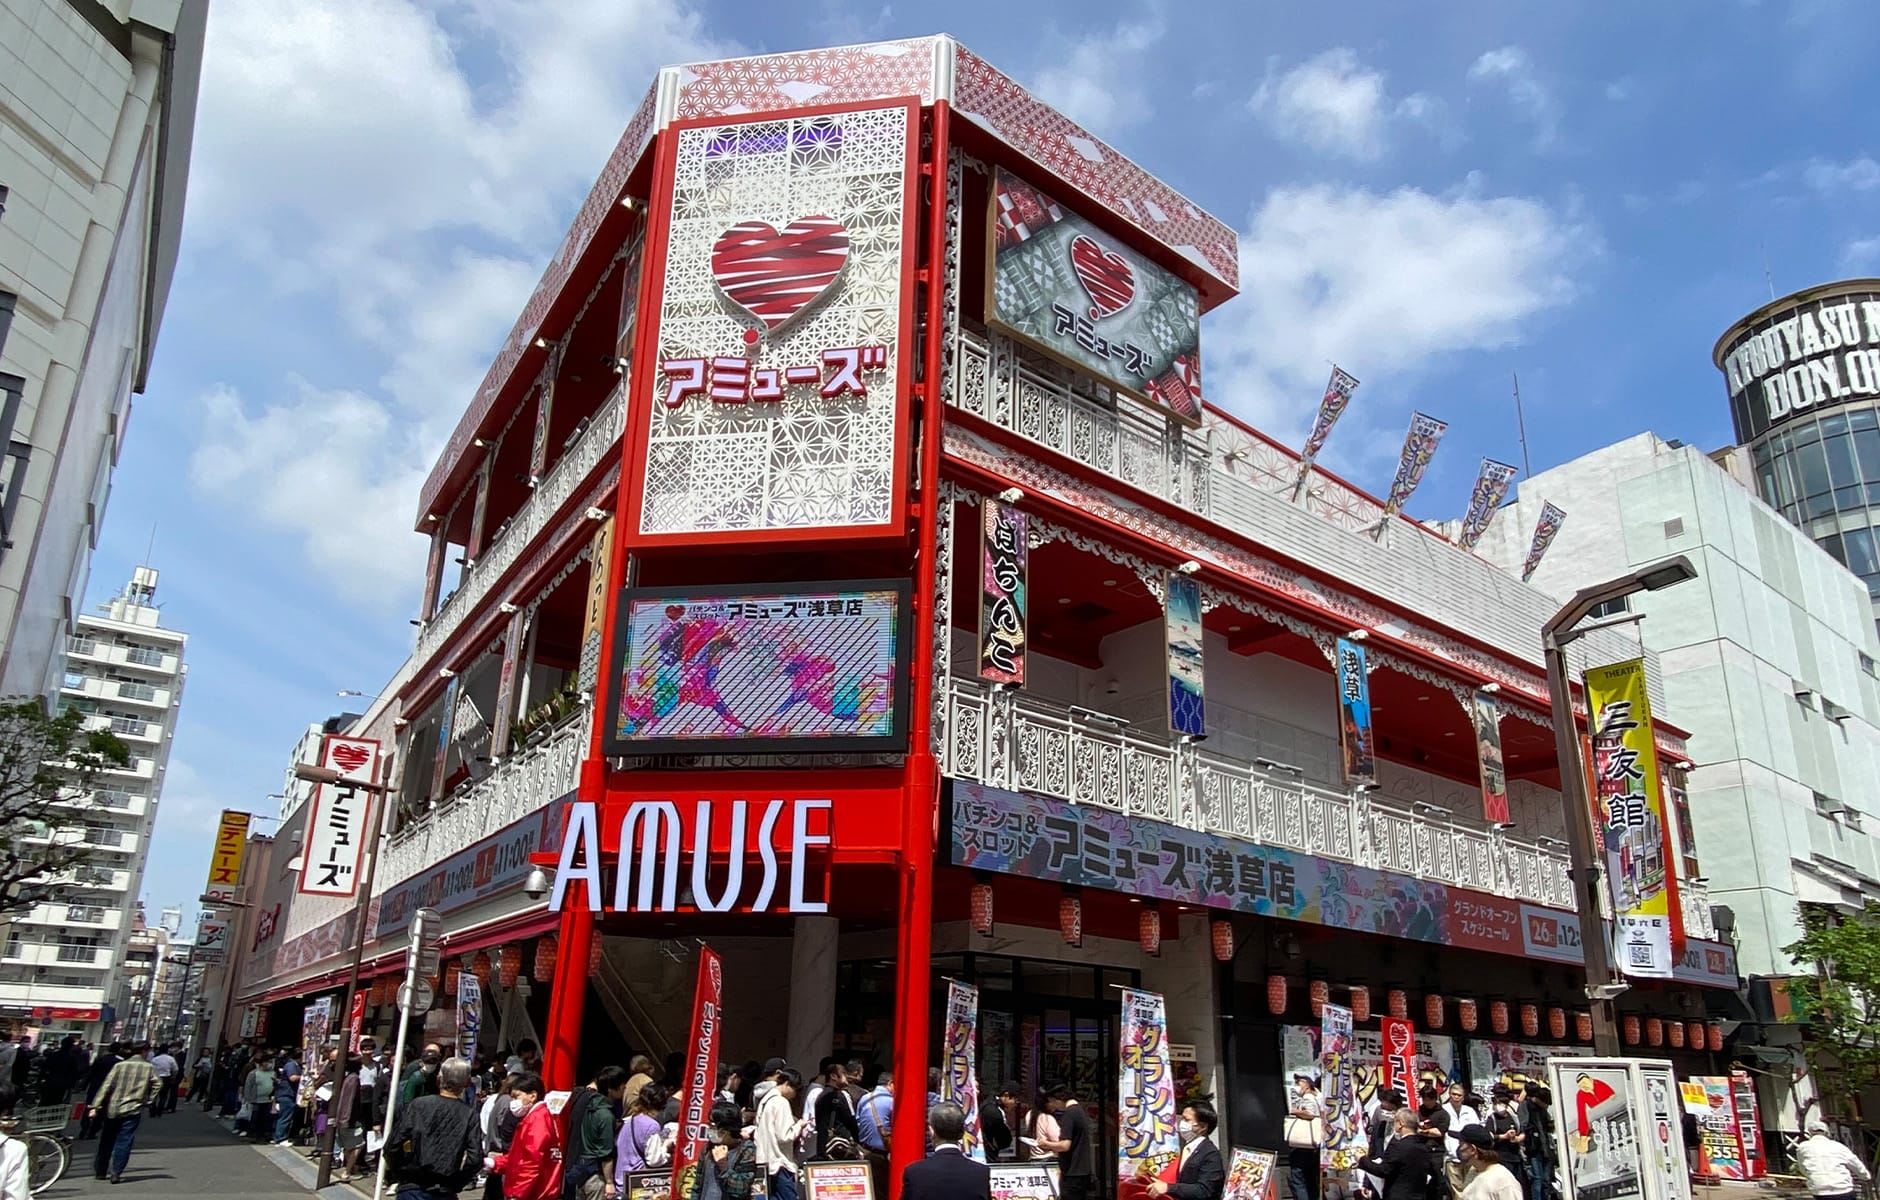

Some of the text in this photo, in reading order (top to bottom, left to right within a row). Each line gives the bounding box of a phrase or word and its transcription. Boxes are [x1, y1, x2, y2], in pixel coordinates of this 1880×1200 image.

[662, 346, 887, 408] アミューズ
[1053, 303, 1153, 377] アミューズ
[1603, 699, 1646, 828] 三友館
[316, 783, 352, 887] アミューズ
[547, 799, 832, 912] AMUSE
[953, 801, 1039, 836] パチンコ&
[963, 828, 1032, 859] スロット
[1453, 900, 1518, 925] グランドオープン
[1134, 995, 1161, 1008] アミューズ
[1123, 1044, 1151, 1158] オープン
[1141, 1024, 1175, 1144] グランド
[1325, 1052, 1343, 1150] オープン
